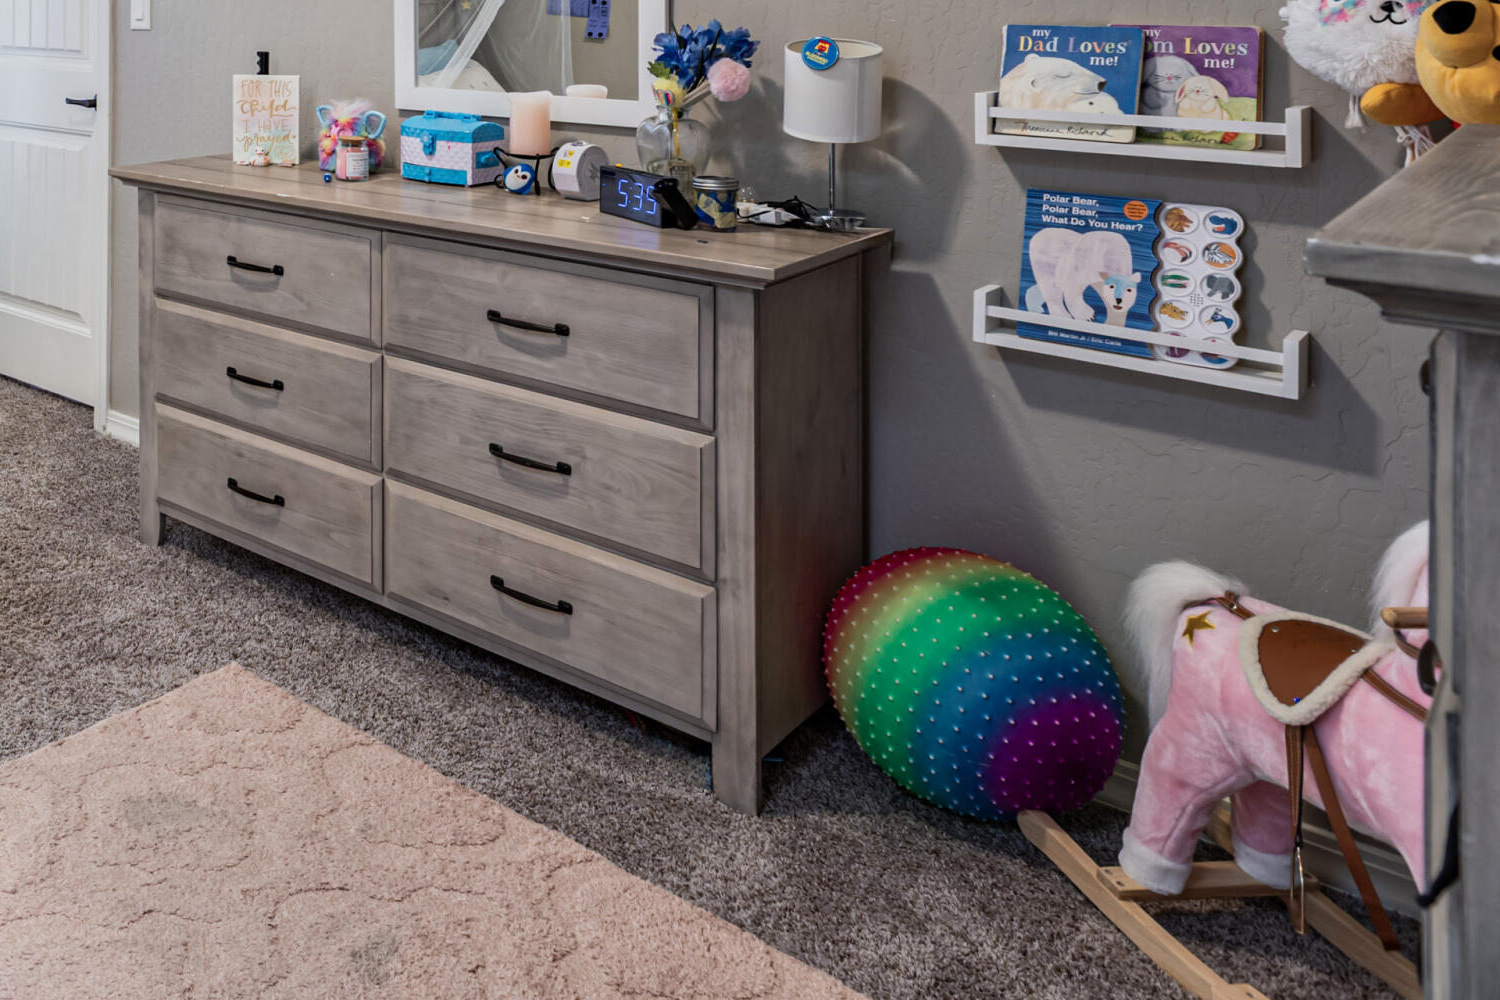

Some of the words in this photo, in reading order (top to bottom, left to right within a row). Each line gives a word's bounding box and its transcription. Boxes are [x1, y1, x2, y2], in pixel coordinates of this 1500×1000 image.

[1032, 29, 1052, 39] my
[1018, 35, 1059, 53] Dad
[1067, 37, 1127, 54] Loves
[1183, 37, 1248, 56] Loves
[1089, 56, 1119, 67] me!
[1203, 58, 1235, 69] me!
[241, 80, 260, 98] FOR
[268, 80, 293, 98] THIS
[236, 99, 297, 118] Child
[258, 119, 290, 133] HAVE
[236, 130, 293, 153] prayed
[617, 179, 657, 215] 5:35
[1043, 193, 1070, 204] Polar
[1073, 196, 1100, 207] Bear,
[1042, 204, 1069, 214] Polar
[1072, 206, 1099, 218] Bear,
[1042, 214, 1068, 225] What
[1071, 217, 1085, 226] Do
[1088, 219, 1108, 229] You
[1111, 221, 1144, 232] Hear?
